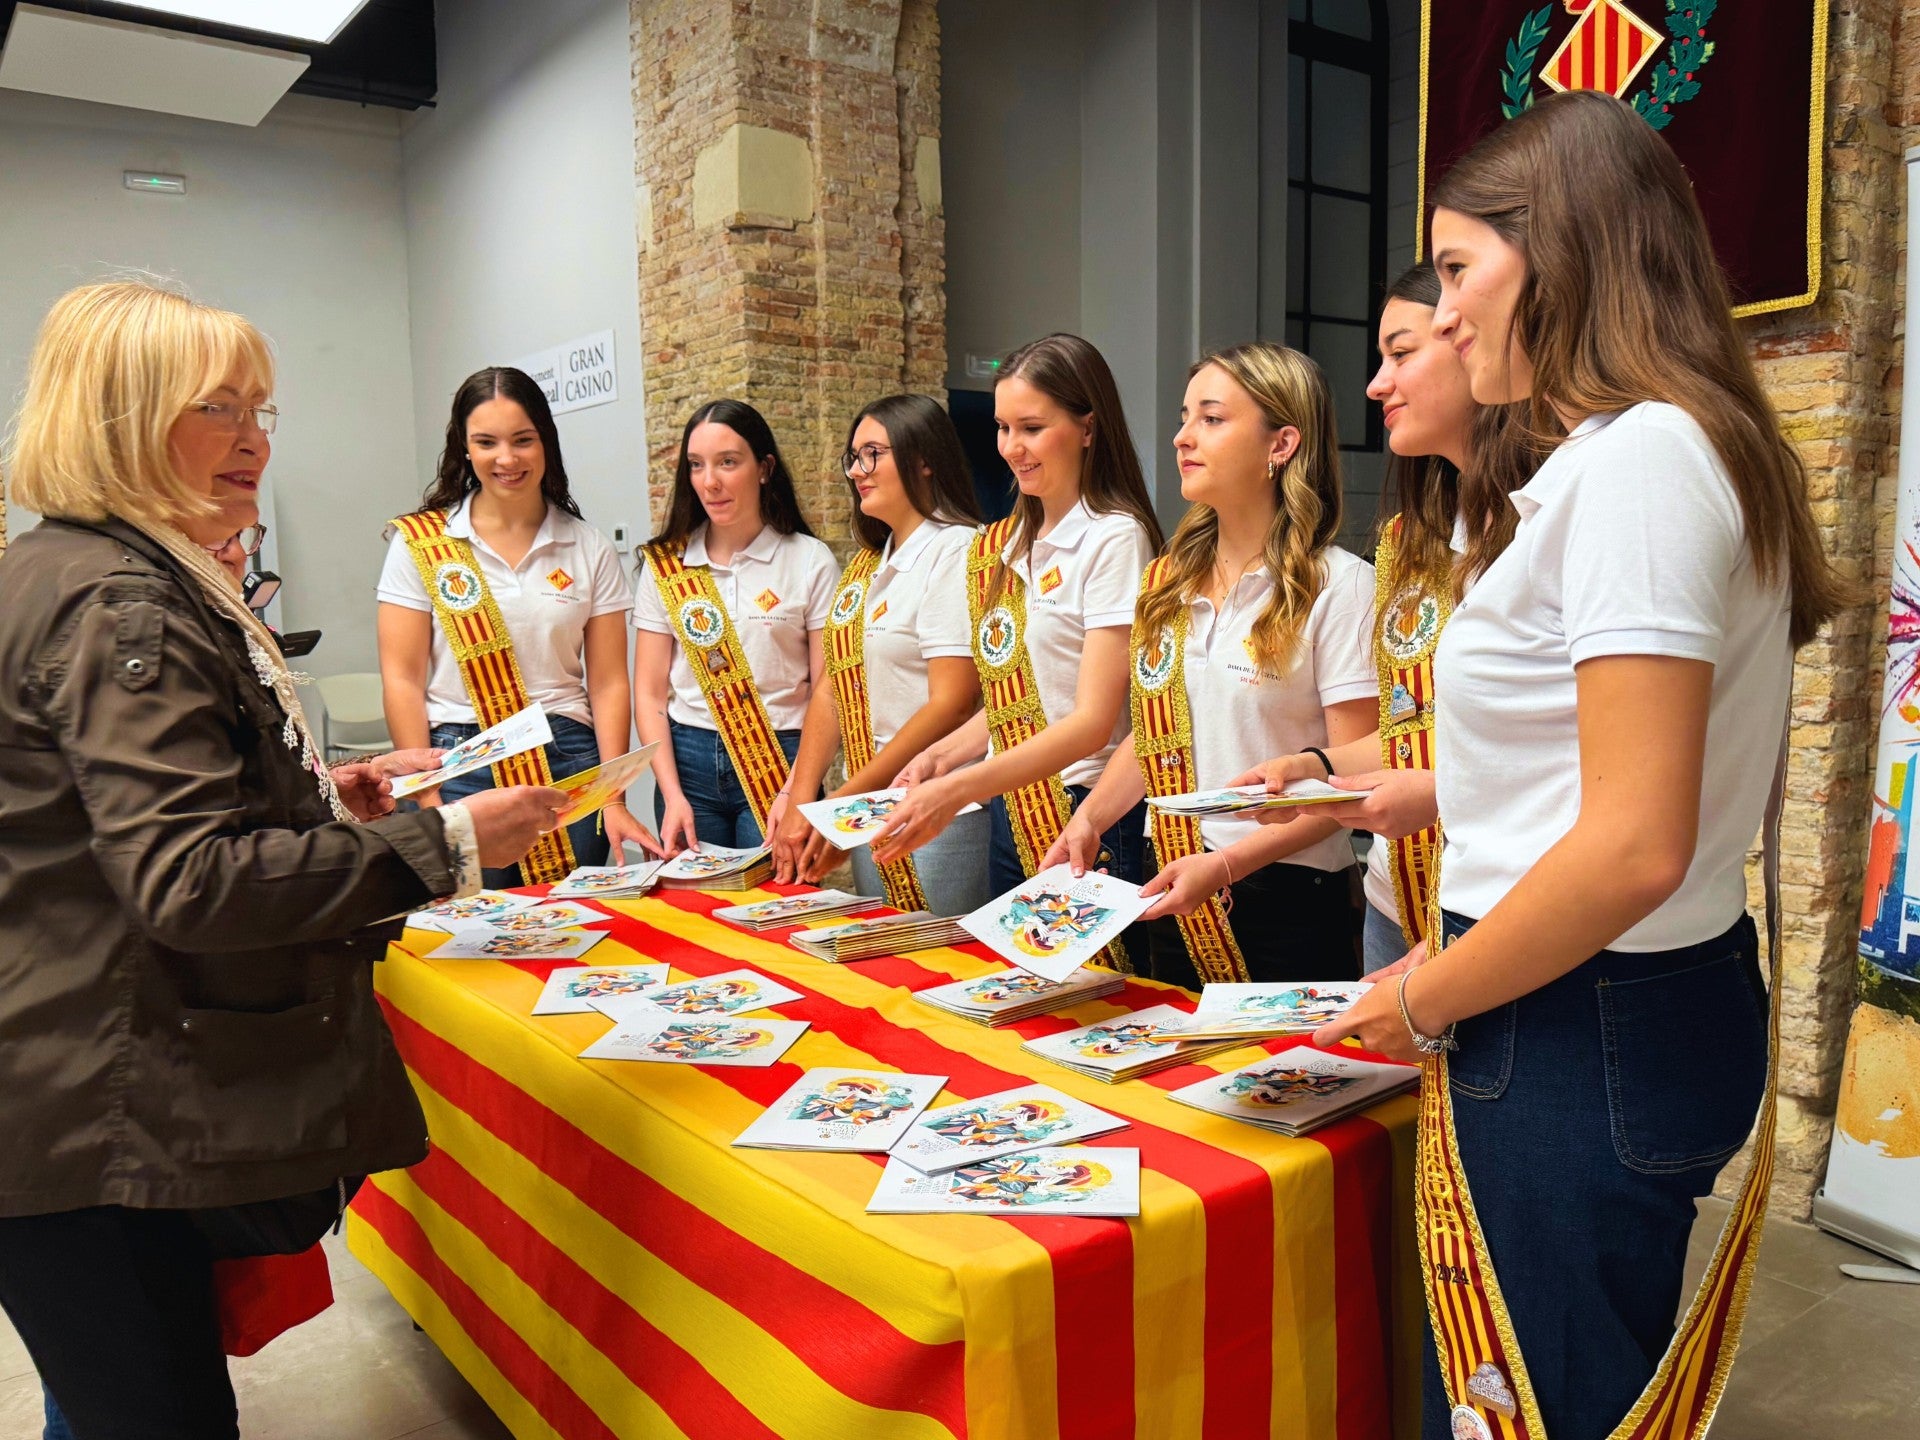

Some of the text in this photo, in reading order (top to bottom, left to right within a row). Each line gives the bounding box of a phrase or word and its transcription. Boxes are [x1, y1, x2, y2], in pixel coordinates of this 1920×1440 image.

[569, 342, 604, 373] GRAN
[565, 370, 613, 401] CASINO
[1436, 1263, 1470, 1286] 2024
